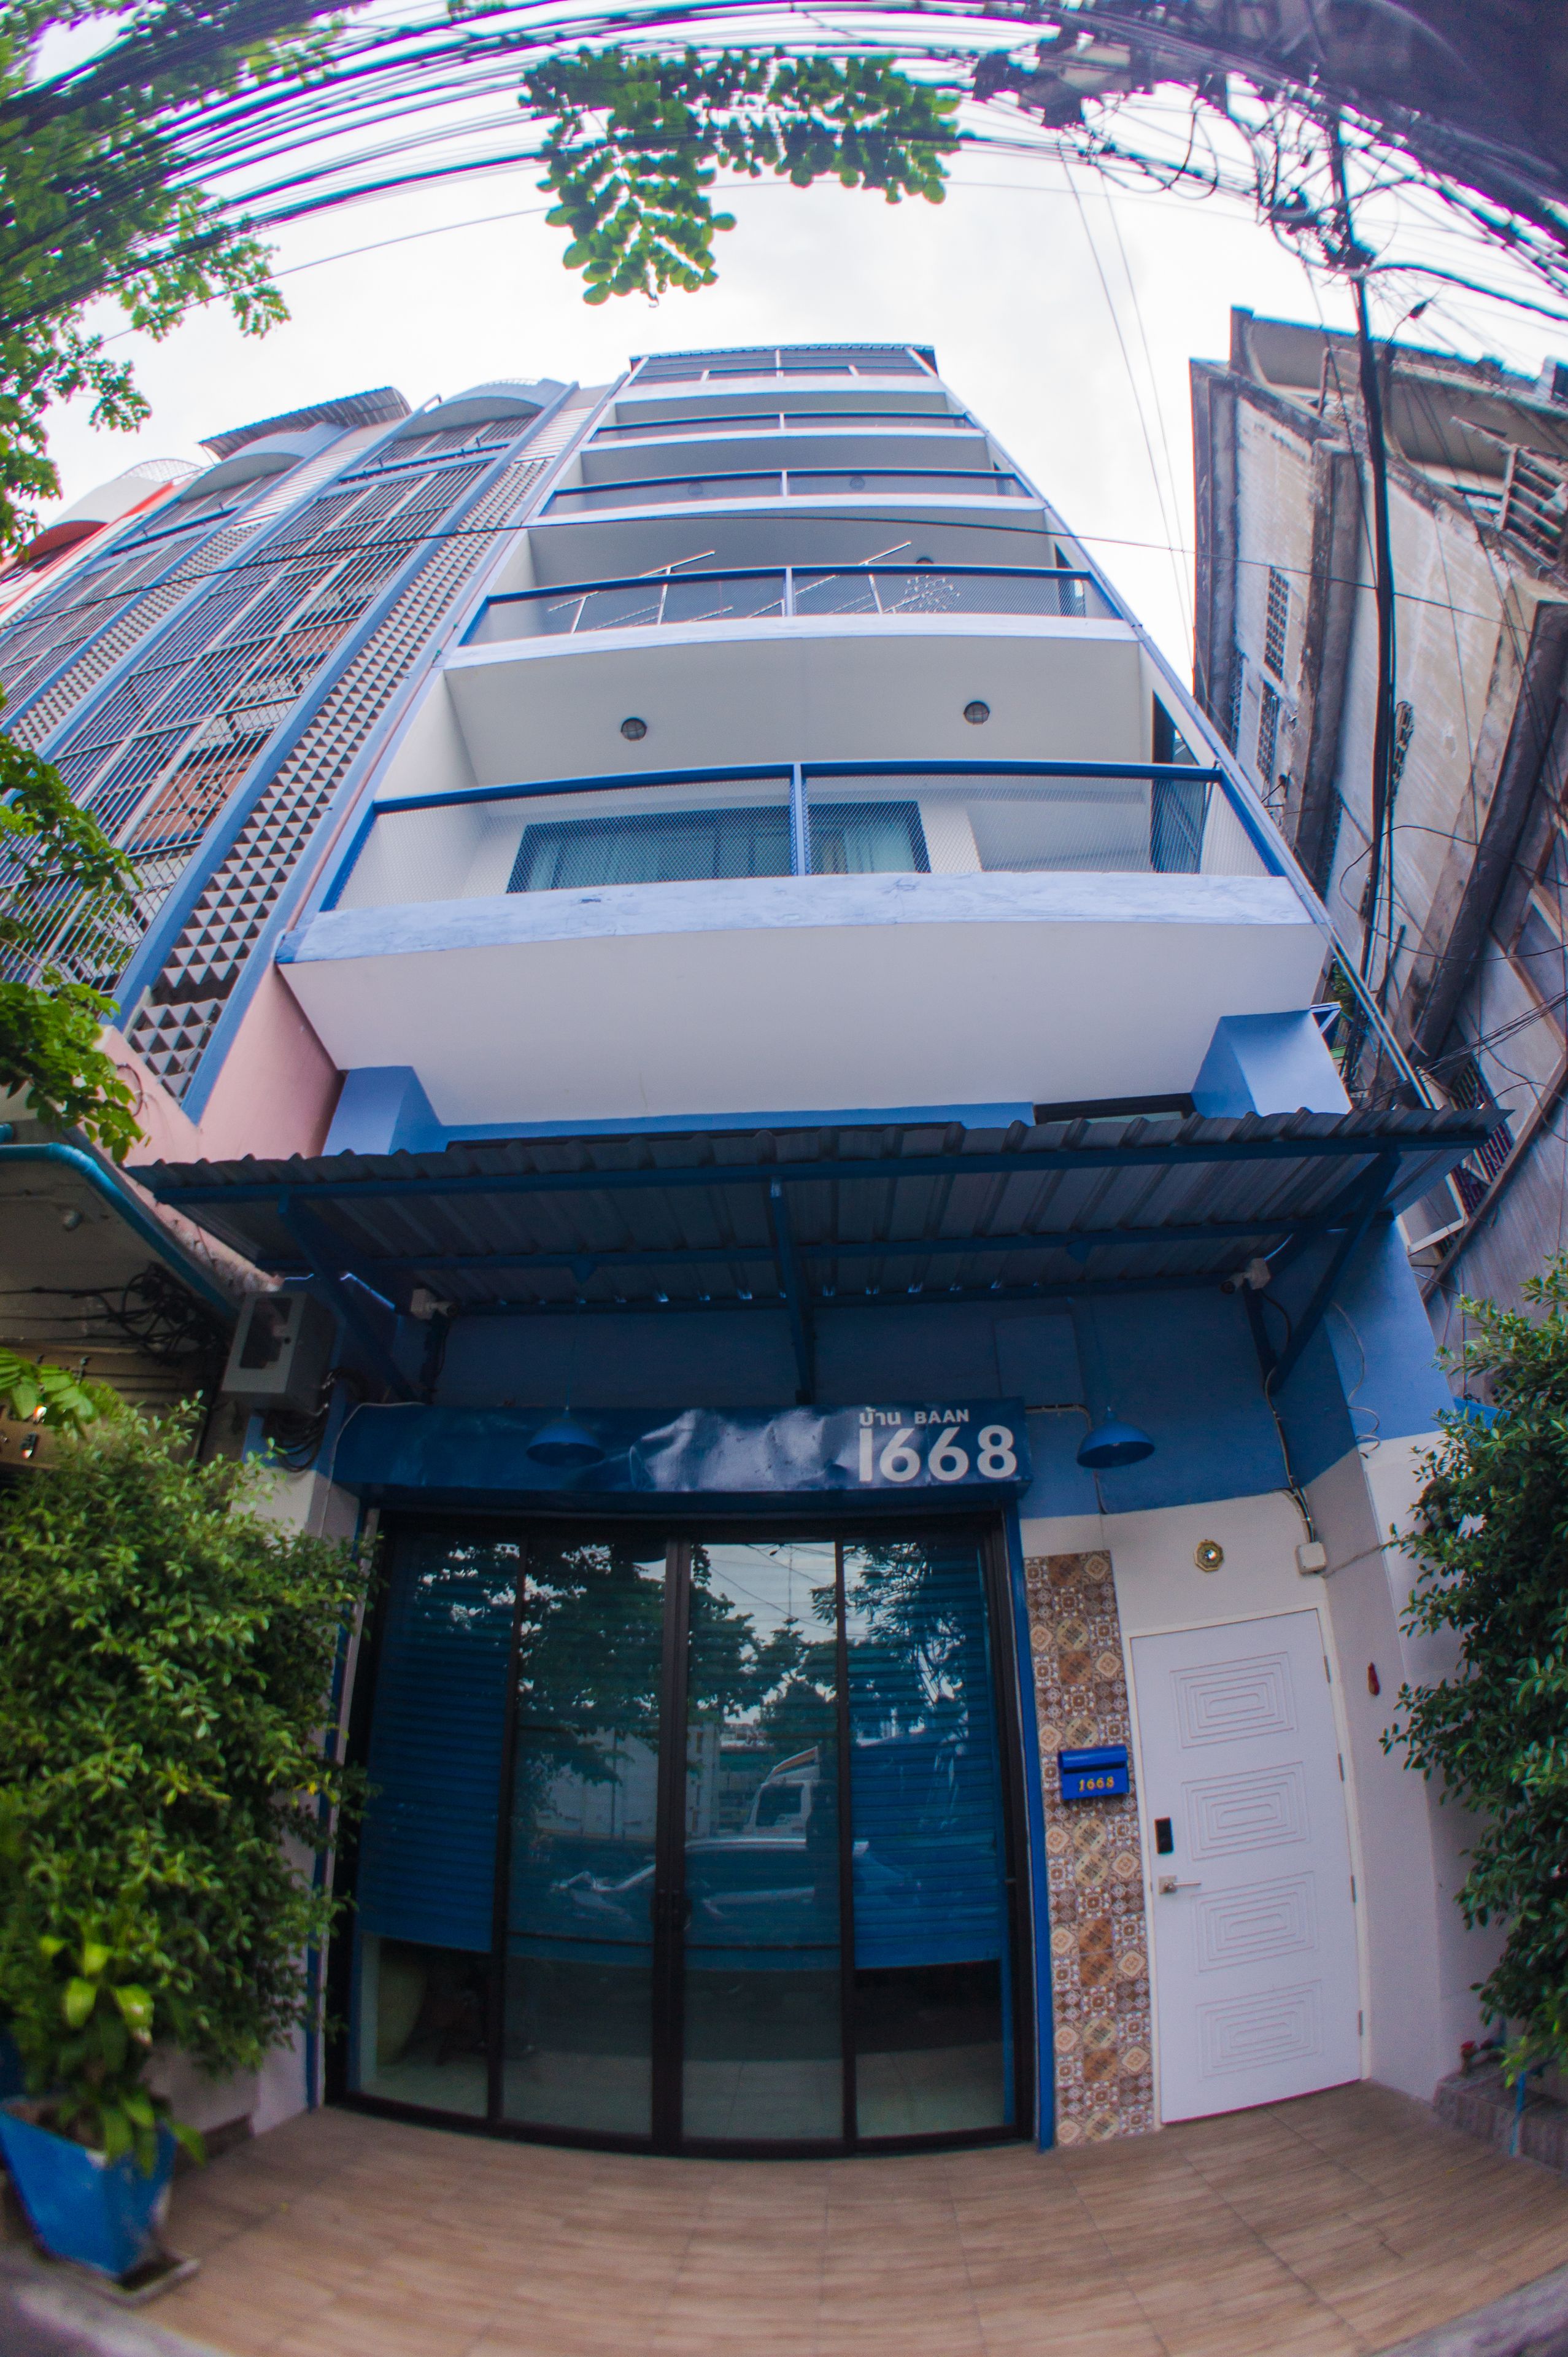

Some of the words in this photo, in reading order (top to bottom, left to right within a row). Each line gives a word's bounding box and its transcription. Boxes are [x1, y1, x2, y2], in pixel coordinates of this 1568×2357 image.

[859, 1406, 902, 1426] บ้าน
[914, 1409, 969, 1424] BAAN
[859, 1425, 1018, 1482] 1668
[1079, 1776, 1114, 1792] 1668
